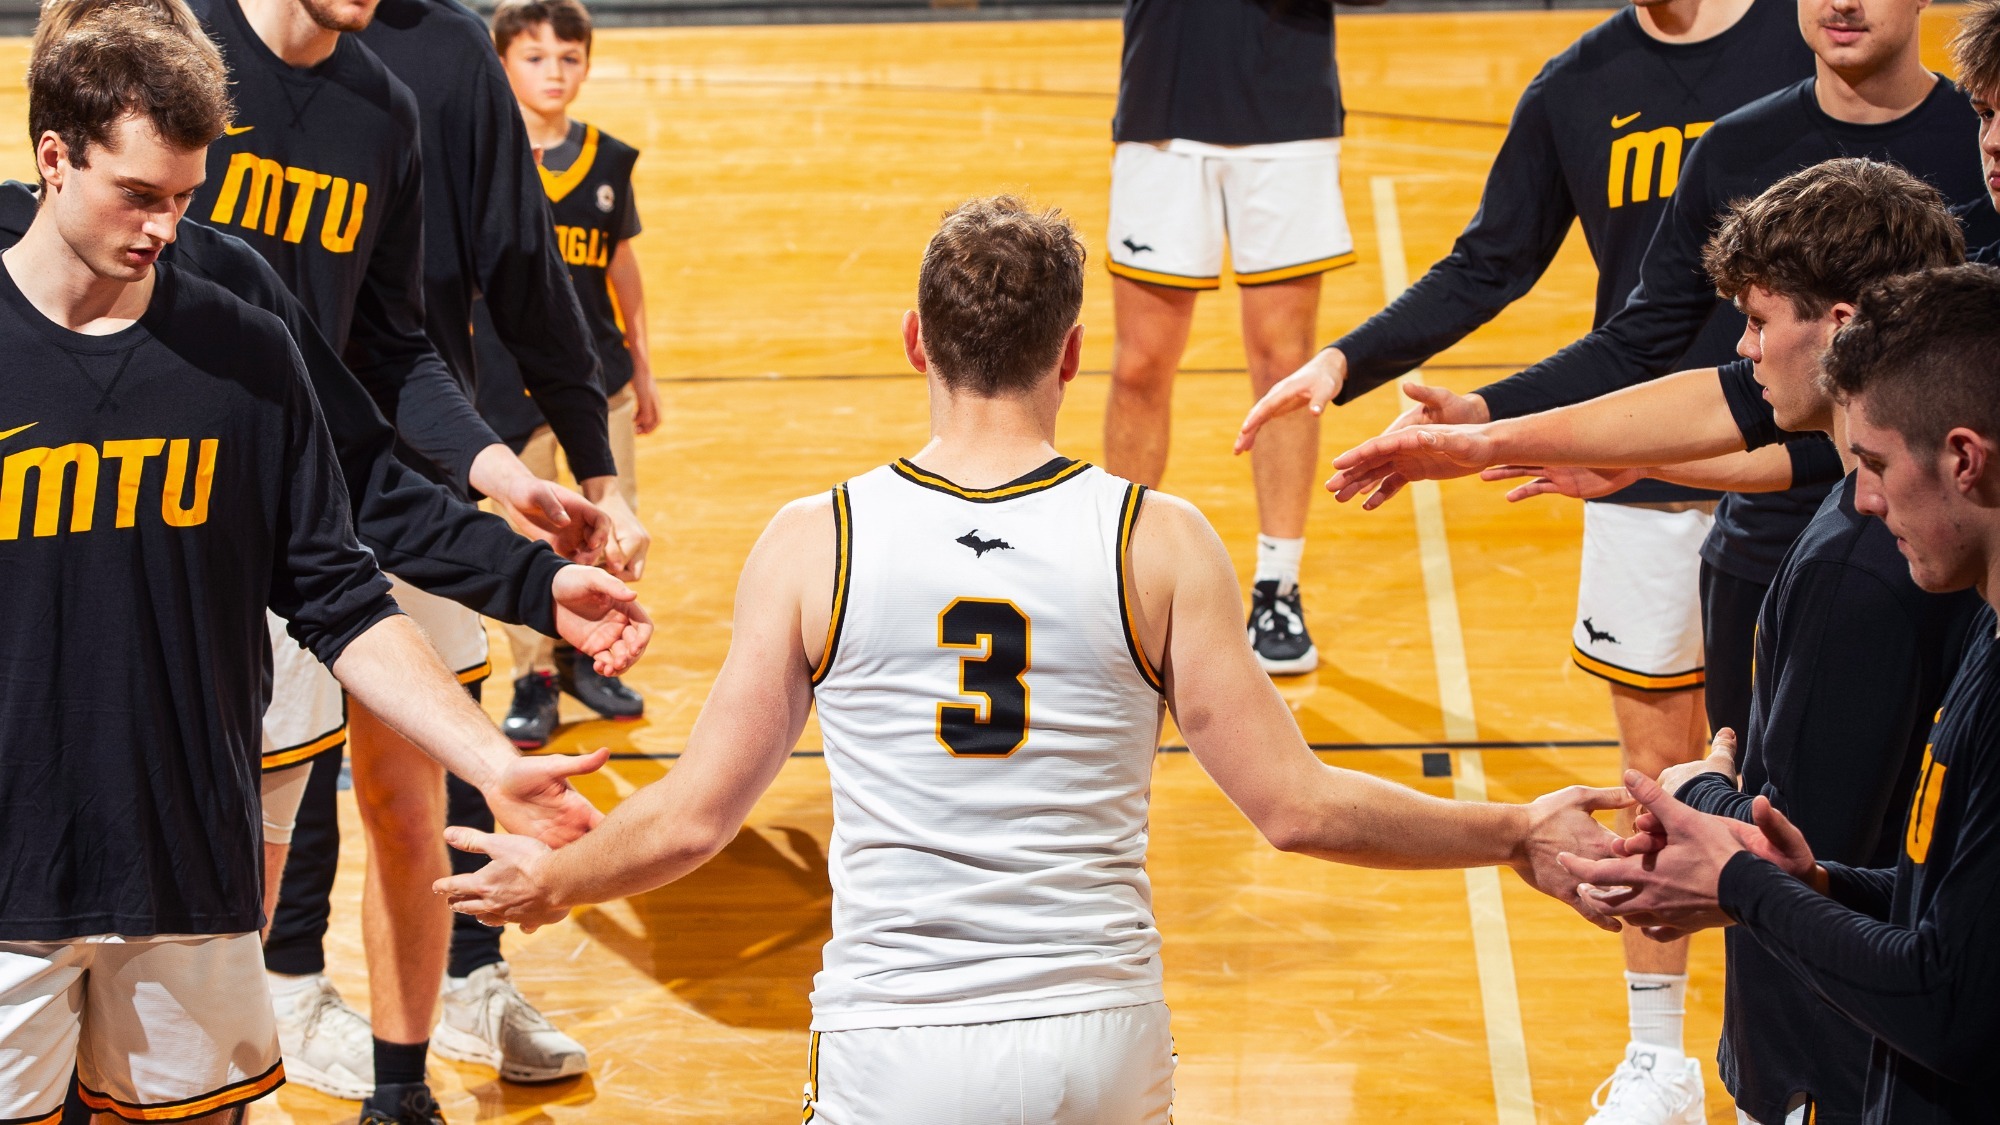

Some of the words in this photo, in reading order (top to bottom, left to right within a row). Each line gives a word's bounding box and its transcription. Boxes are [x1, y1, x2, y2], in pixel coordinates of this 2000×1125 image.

[210, 151, 368, 254] MTU
[0, 437, 220, 541] MTU
[935, 596, 1032, 759] 3
